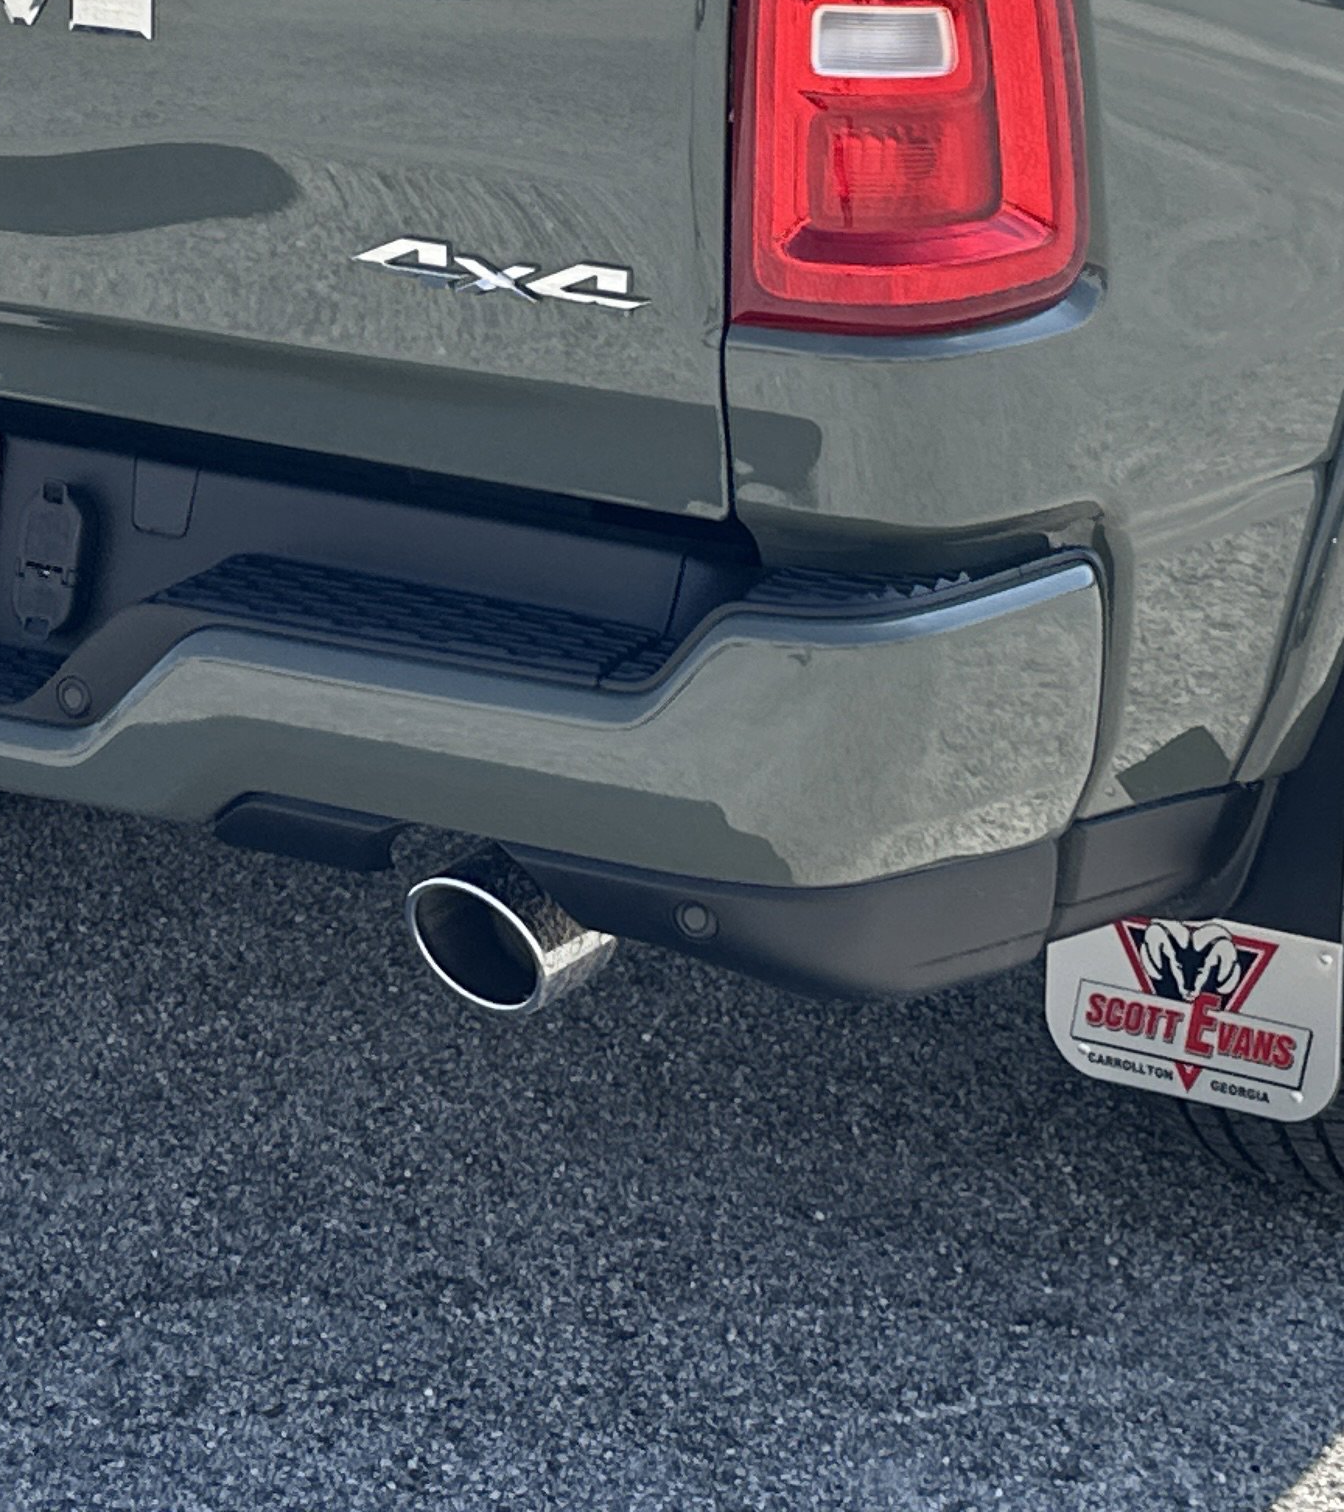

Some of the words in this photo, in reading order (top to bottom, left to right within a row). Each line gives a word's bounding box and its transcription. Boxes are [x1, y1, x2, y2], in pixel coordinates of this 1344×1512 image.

[1085, 992, 1185, 1043] SCOTT
[1185, 991, 1297, 1070] EVANS
[1088, 1051, 1174, 1081] CARROLLTON
[1209, 1079, 1270, 1104] GEORGIA
